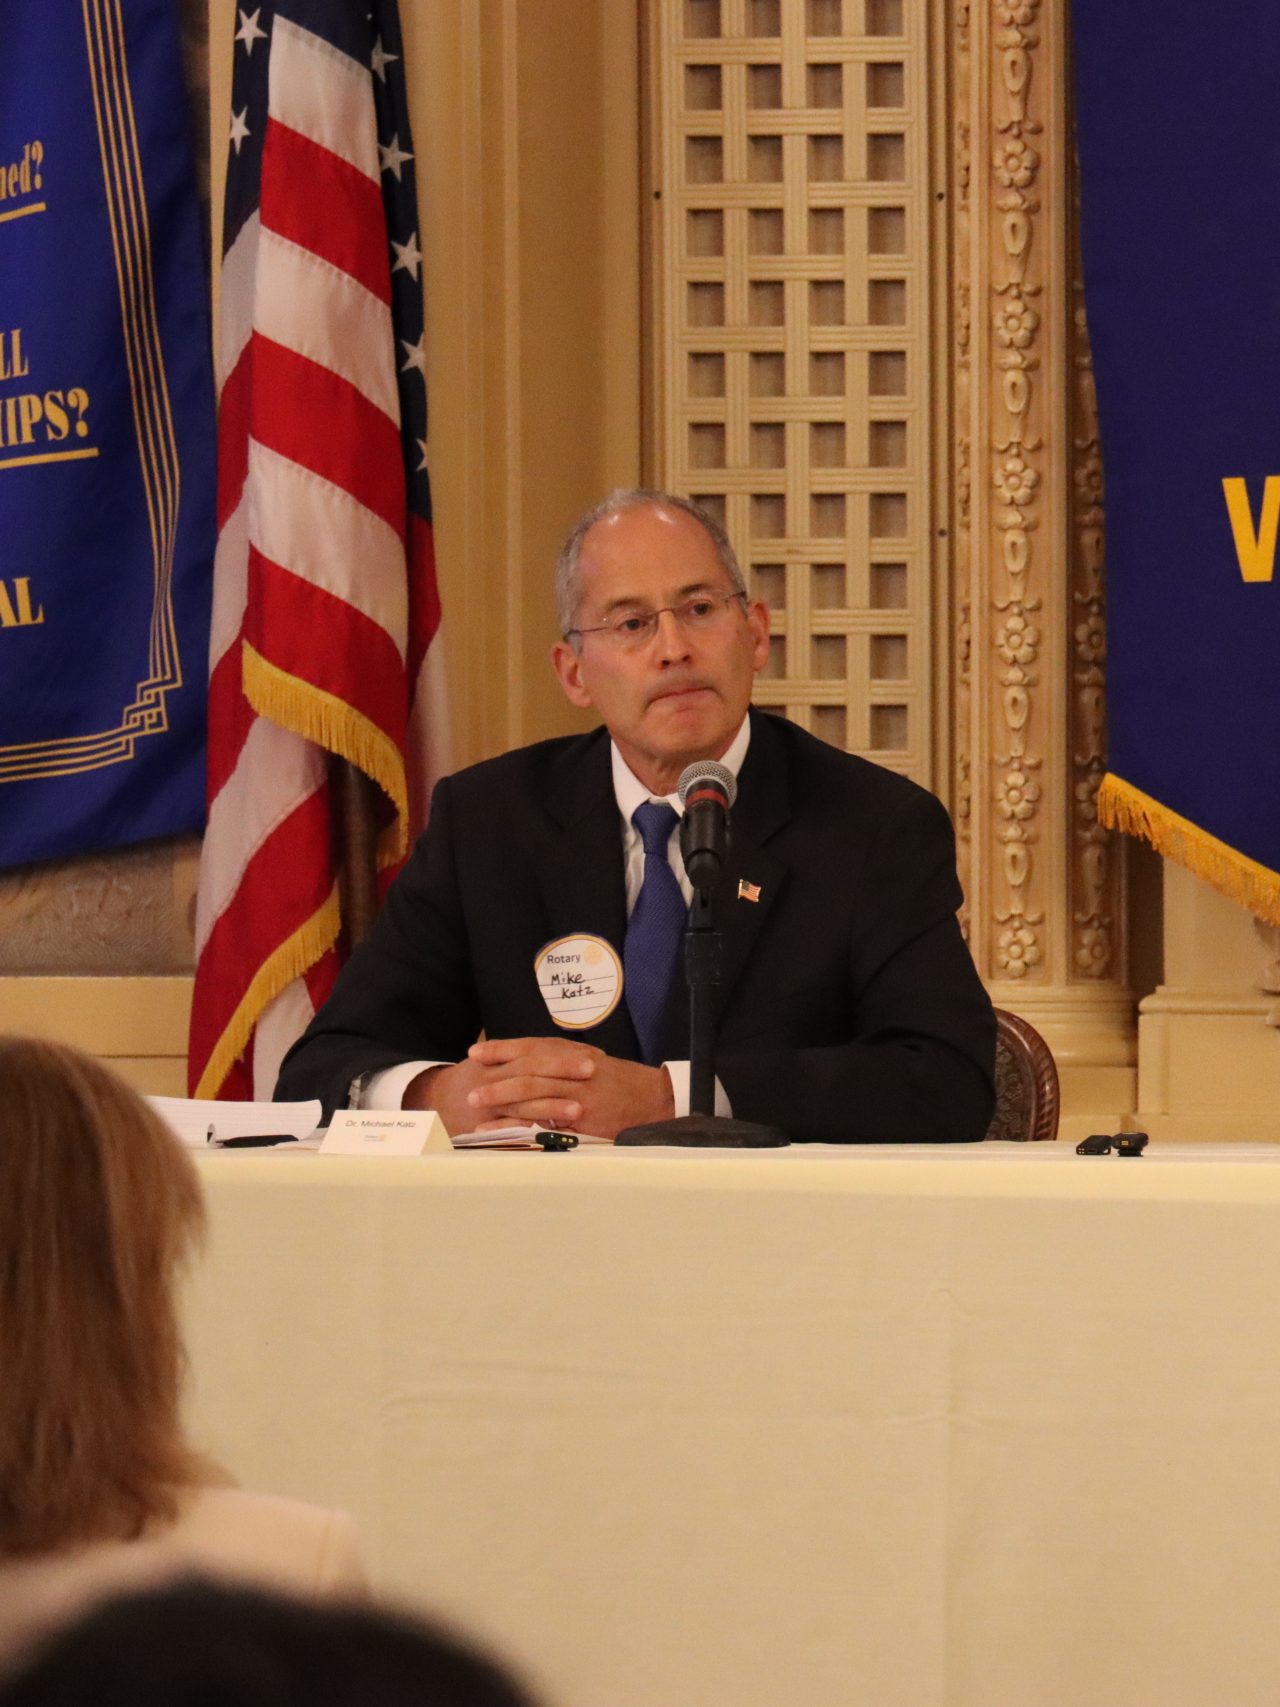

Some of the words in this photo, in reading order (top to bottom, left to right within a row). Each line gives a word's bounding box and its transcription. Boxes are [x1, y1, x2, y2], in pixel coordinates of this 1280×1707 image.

[0, 387, 90, 448] IPS?
[546, 953, 581, 964] Rotary
[551, 972, 586, 985] Mike
[561, 986, 595, 999] Katz
